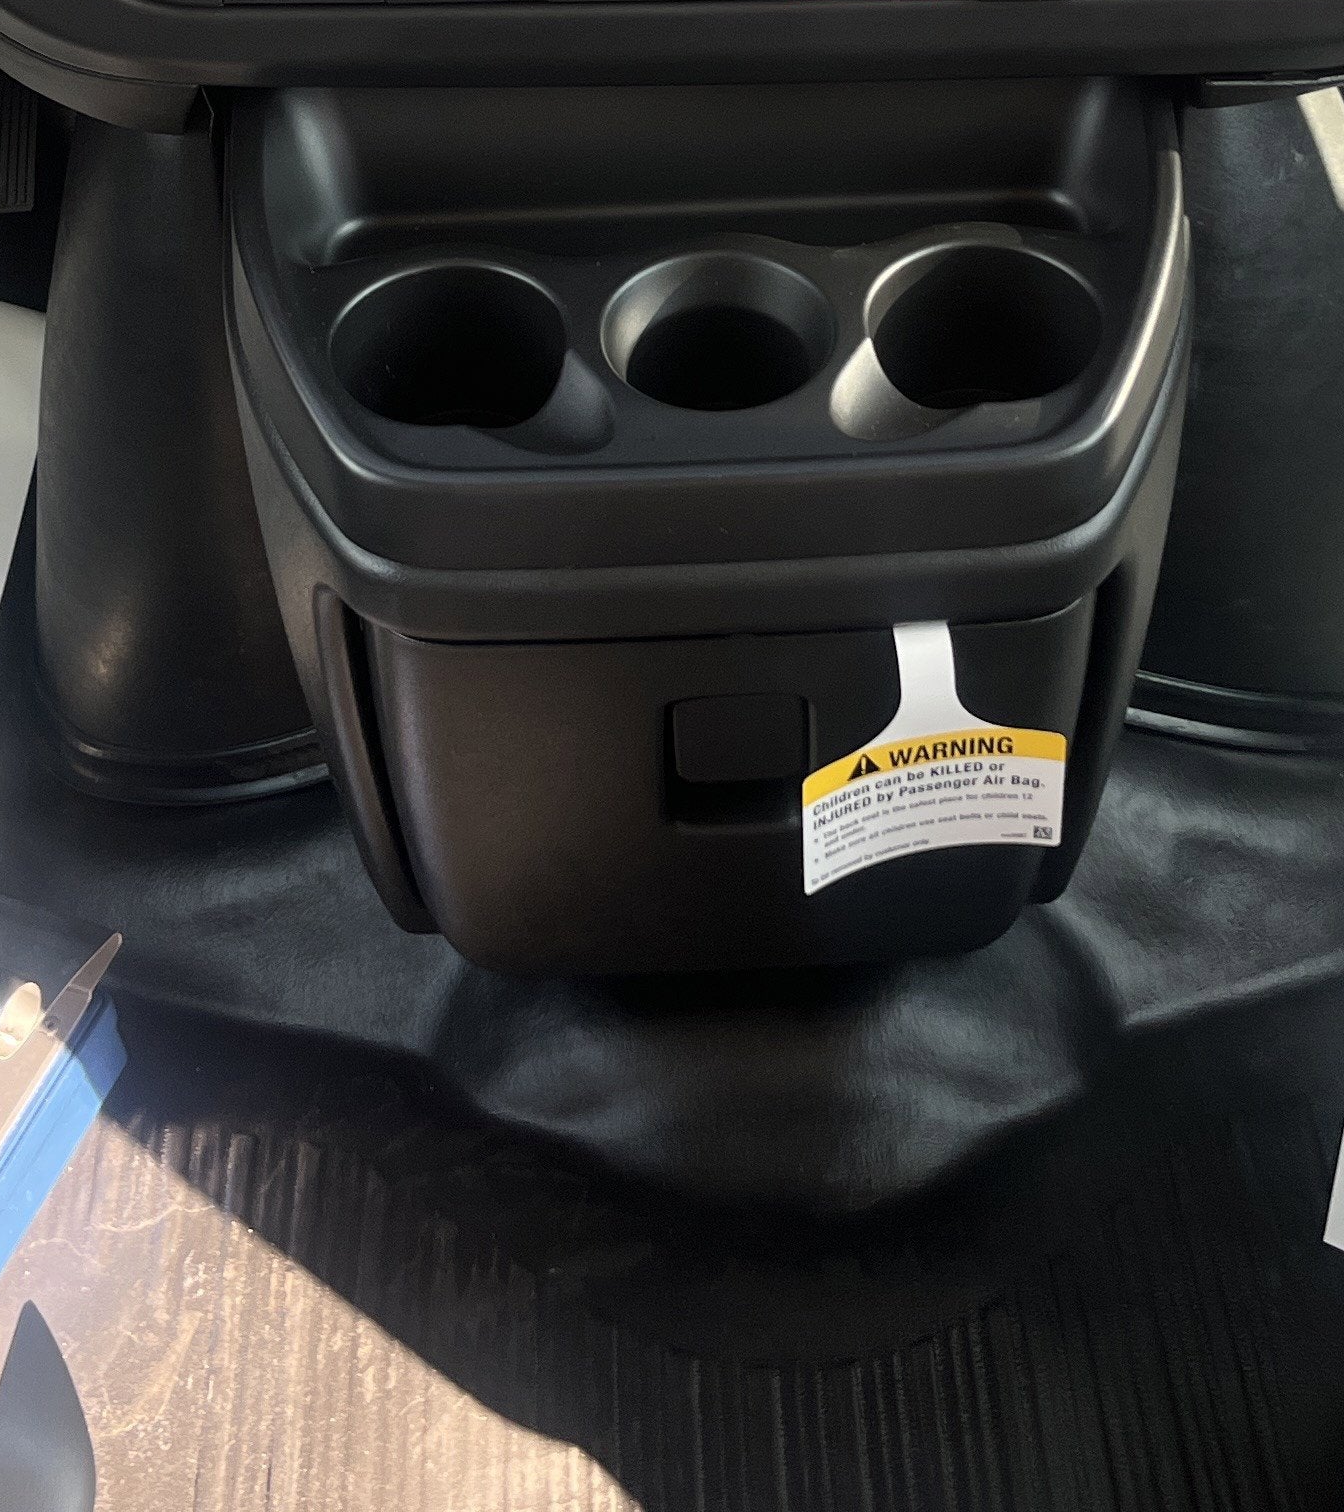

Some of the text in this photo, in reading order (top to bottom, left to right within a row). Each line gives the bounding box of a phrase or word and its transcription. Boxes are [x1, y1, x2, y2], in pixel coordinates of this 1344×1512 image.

[889, 736, 1014, 767] WARNING
[813, 761, 1005, 816] Children can be KILLED or
[813, 796, 871, 830] INJURED
[877, 791, 894, 802] by
[898, 776, 978, 797] Passenger
[983, 775, 1005, 785] Air
[1010, 774, 1046, 788] Bag.
